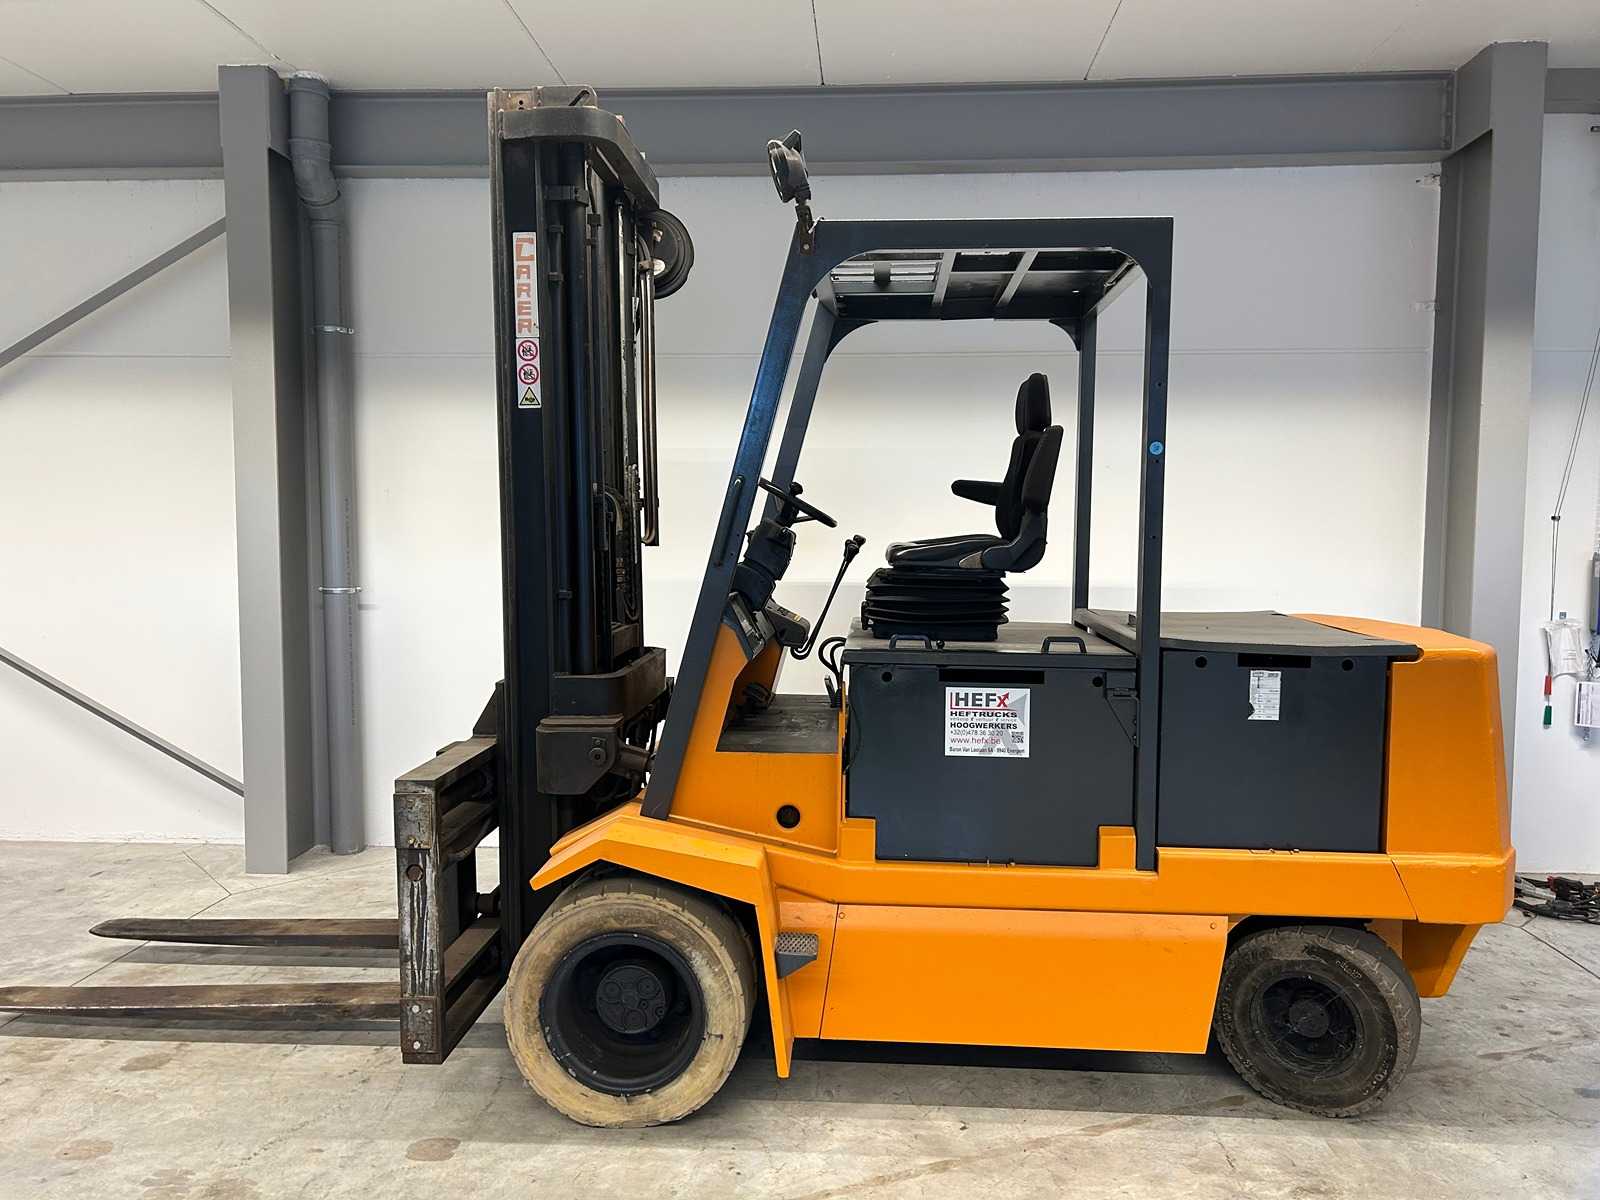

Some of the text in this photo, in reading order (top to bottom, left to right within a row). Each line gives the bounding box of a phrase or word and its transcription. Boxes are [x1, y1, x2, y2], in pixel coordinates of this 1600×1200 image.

[515, 237, 535, 333] CARER
[950, 722, 1018, 730] HOOGWERKERS
[950, 737, 1001, 745] www.hefx.be
